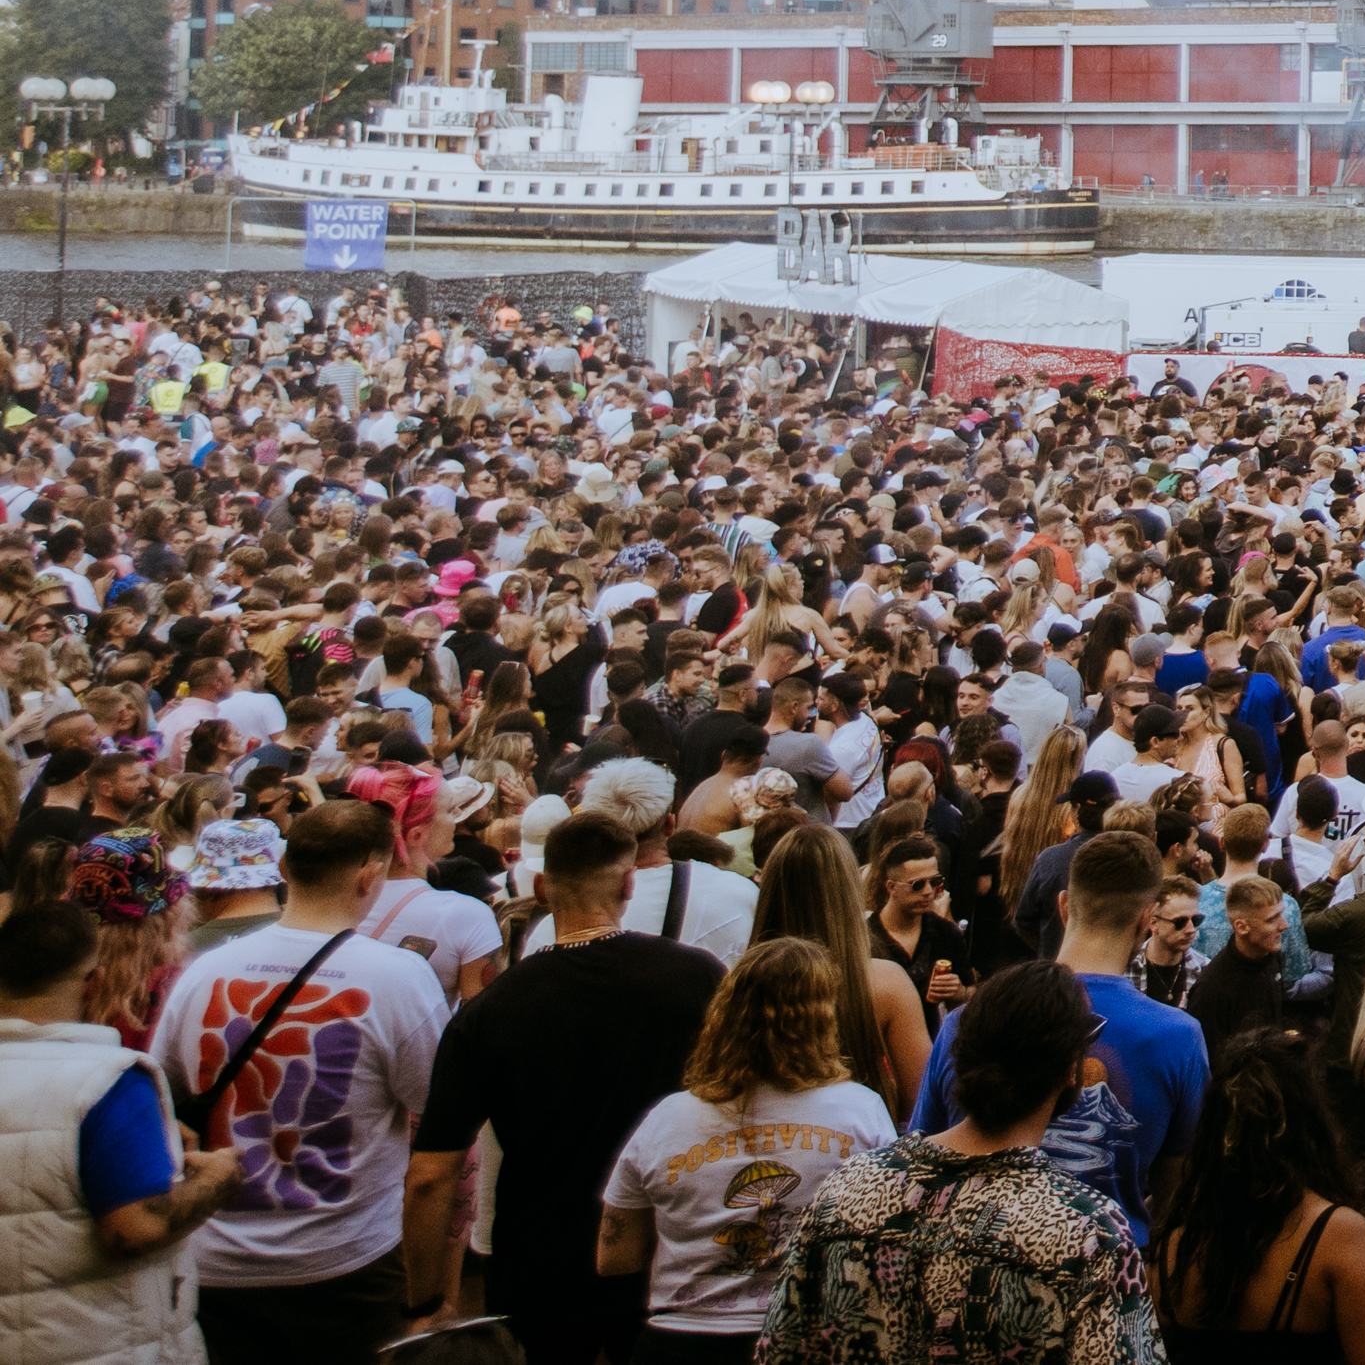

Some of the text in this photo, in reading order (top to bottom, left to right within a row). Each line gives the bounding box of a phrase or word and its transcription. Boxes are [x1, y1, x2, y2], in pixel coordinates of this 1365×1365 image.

[932, 34, 948, 48] 29
[312, 204, 385, 221] WATER
[313, 223, 380, 240] POINT
[777, 207, 853, 286] BAR
[1215, 333, 1261, 347] JCB
[668, 1122, 855, 1185] POSITIVITY
